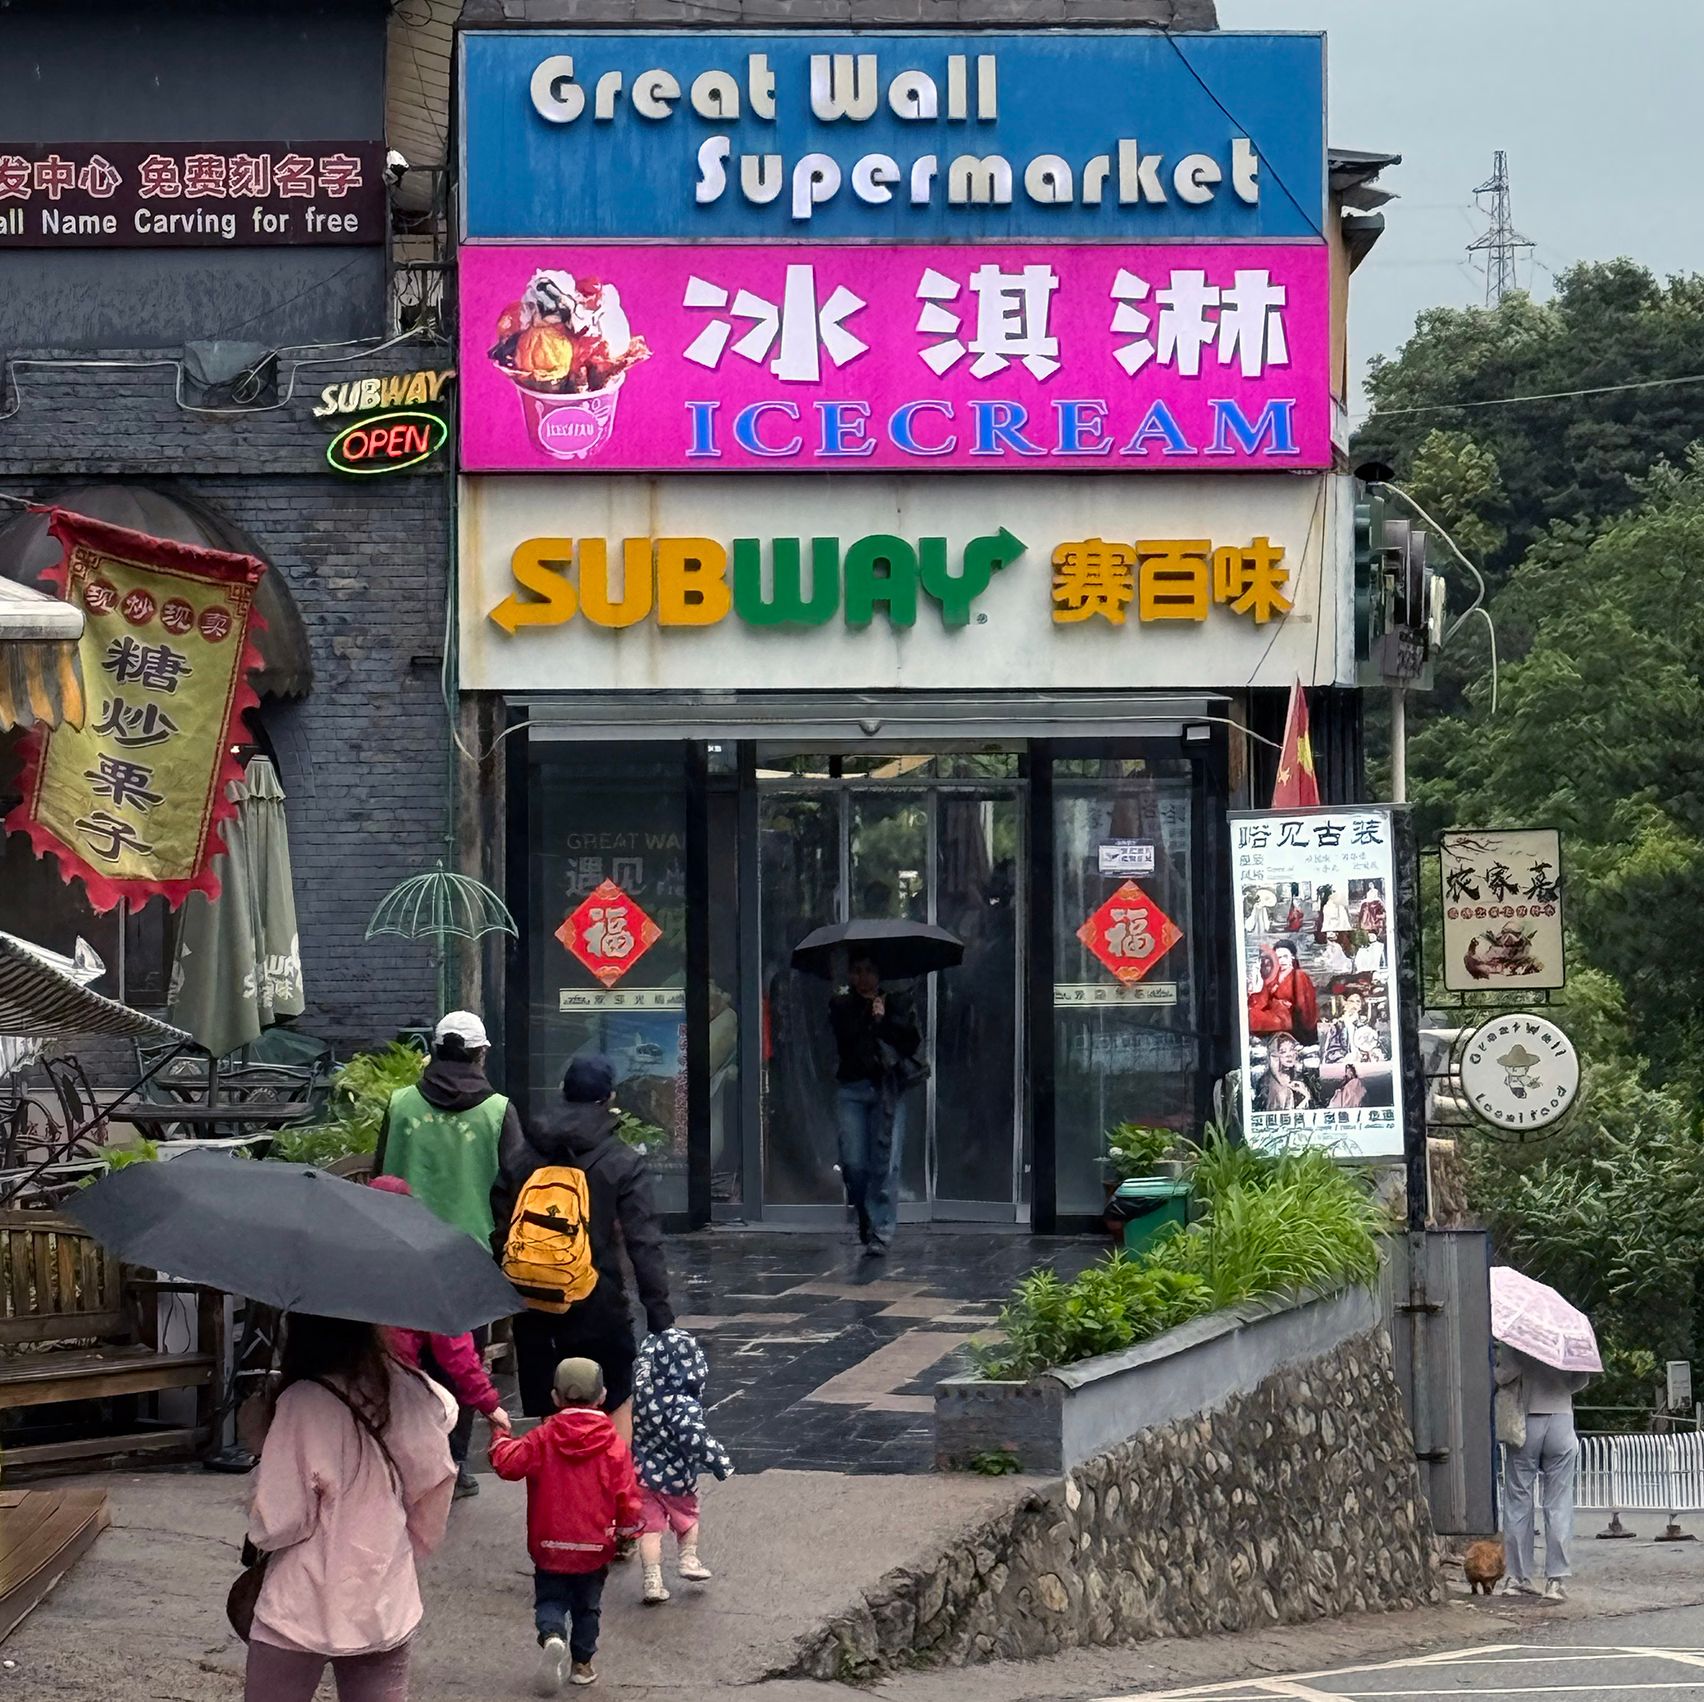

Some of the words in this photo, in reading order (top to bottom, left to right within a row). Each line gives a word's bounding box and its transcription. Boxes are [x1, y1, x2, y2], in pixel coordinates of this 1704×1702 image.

[528, 53, 778, 124] Great
[809, 53, 998, 122] Wall
[0, 154, 123, 200] 发中心
[138, 153, 363, 200] 免费刻名字
[695, 135, 1261, 220] Supermarket
[42, 208, 117, 235] Name
[134, 207, 237, 239] Carving
[252, 206, 290, 234] for
[305, 206, 359, 233] free
[682, 263, 1290, 383] 冰淇淋
[312, 370, 456, 418] SUBWAY
[342, 424, 431, 461] OPEN
[685, 397, 1300, 458] ICECREAM
[489, 525, 1029, 637] SUBWAY
[1051, 535, 1294, 628] 赛百味
[74, 635, 193, 863] 糖炒栗子
[582, 907, 635, 959] 福
[1104, 908, 1155, 959] 福
